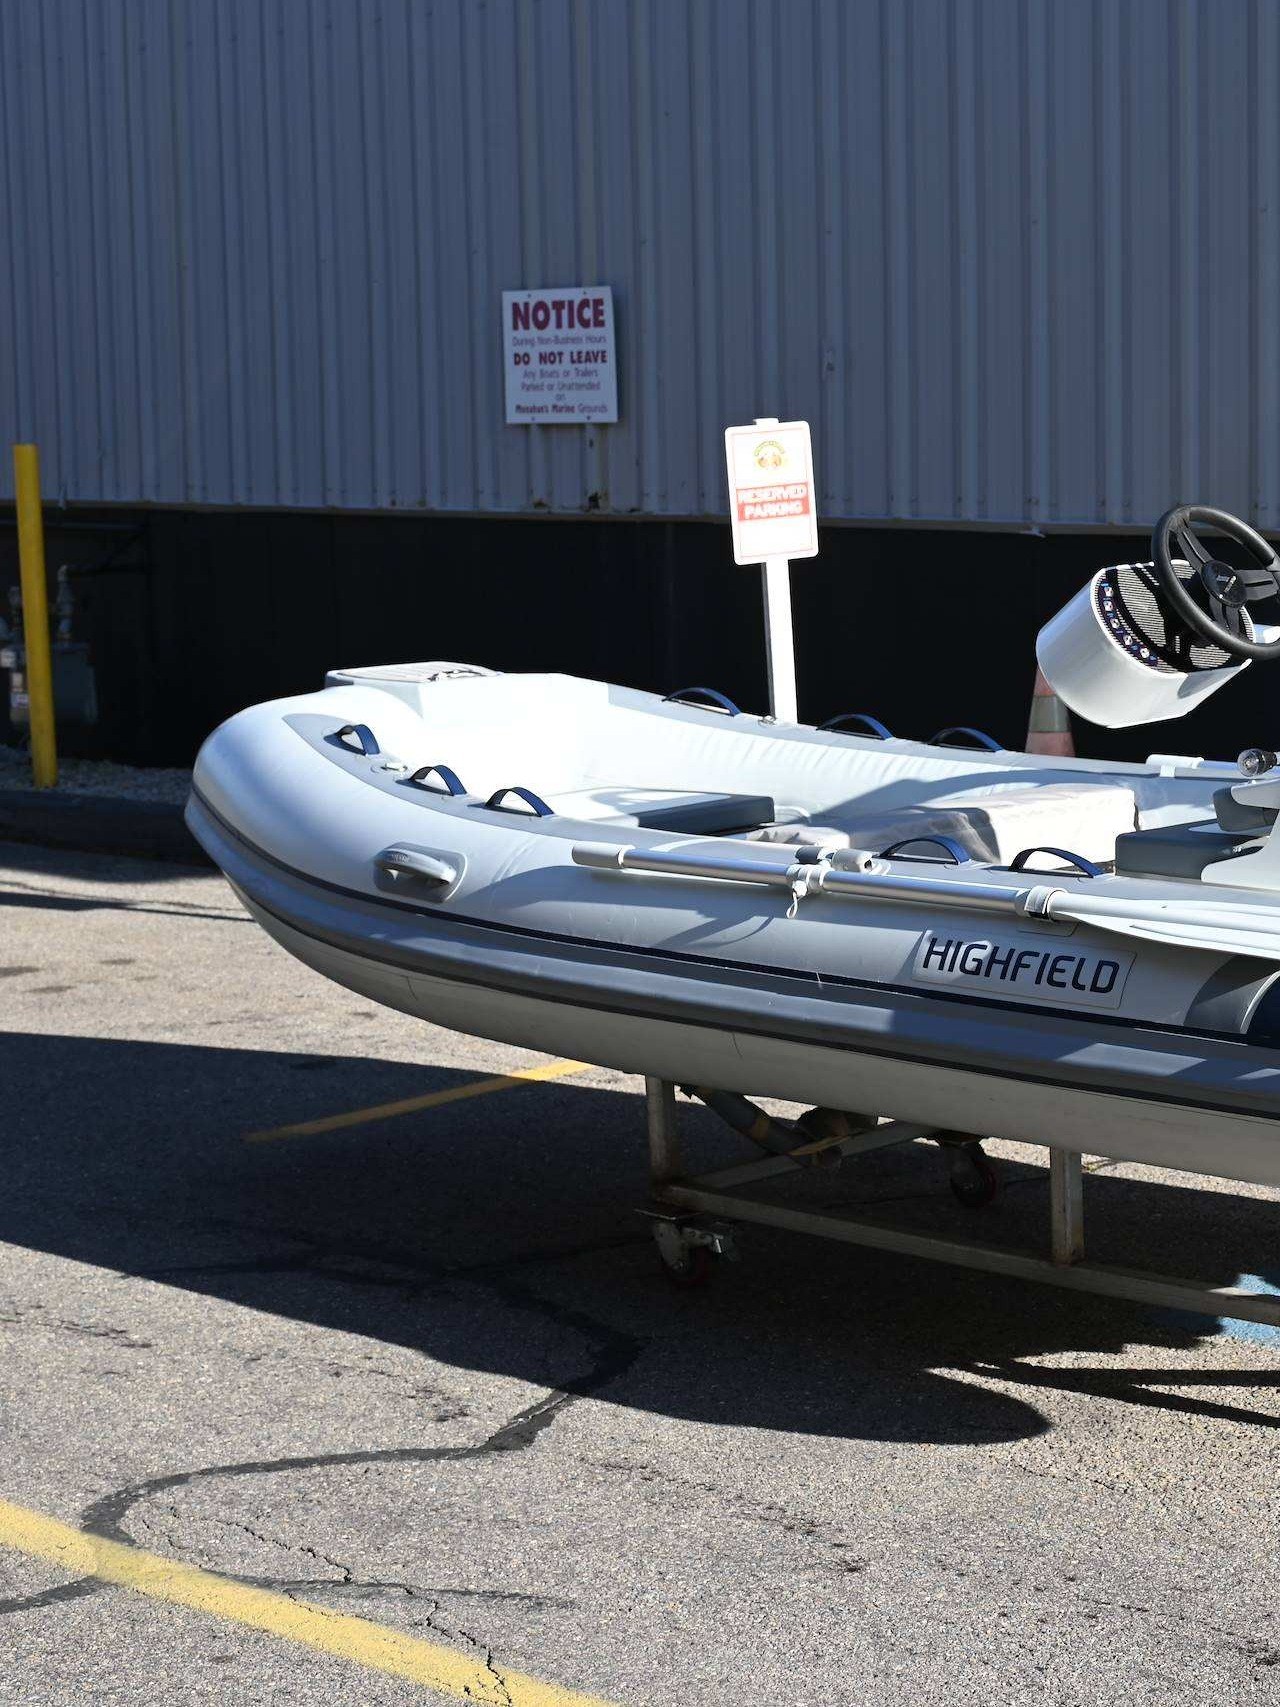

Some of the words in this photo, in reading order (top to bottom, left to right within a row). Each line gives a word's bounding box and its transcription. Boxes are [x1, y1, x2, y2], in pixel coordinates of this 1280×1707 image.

[511, 297, 606, 331] NOTICE
[585, 334, 607, 344] Hours
[513, 352, 531, 366] DO
[539, 351, 564, 365] NOT
[570, 350, 608, 364] LEAVE
[523, 369, 536, 381] Any
[540, 368, 560, 379] Boats
[563, 369, 571, 378] or
[574, 367, 599, 378] Trailers
[546, 383, 555, 392] or
[551, 403, 576, 414] Marine
[922, 937, 1121, 994] HIGHFIELD
